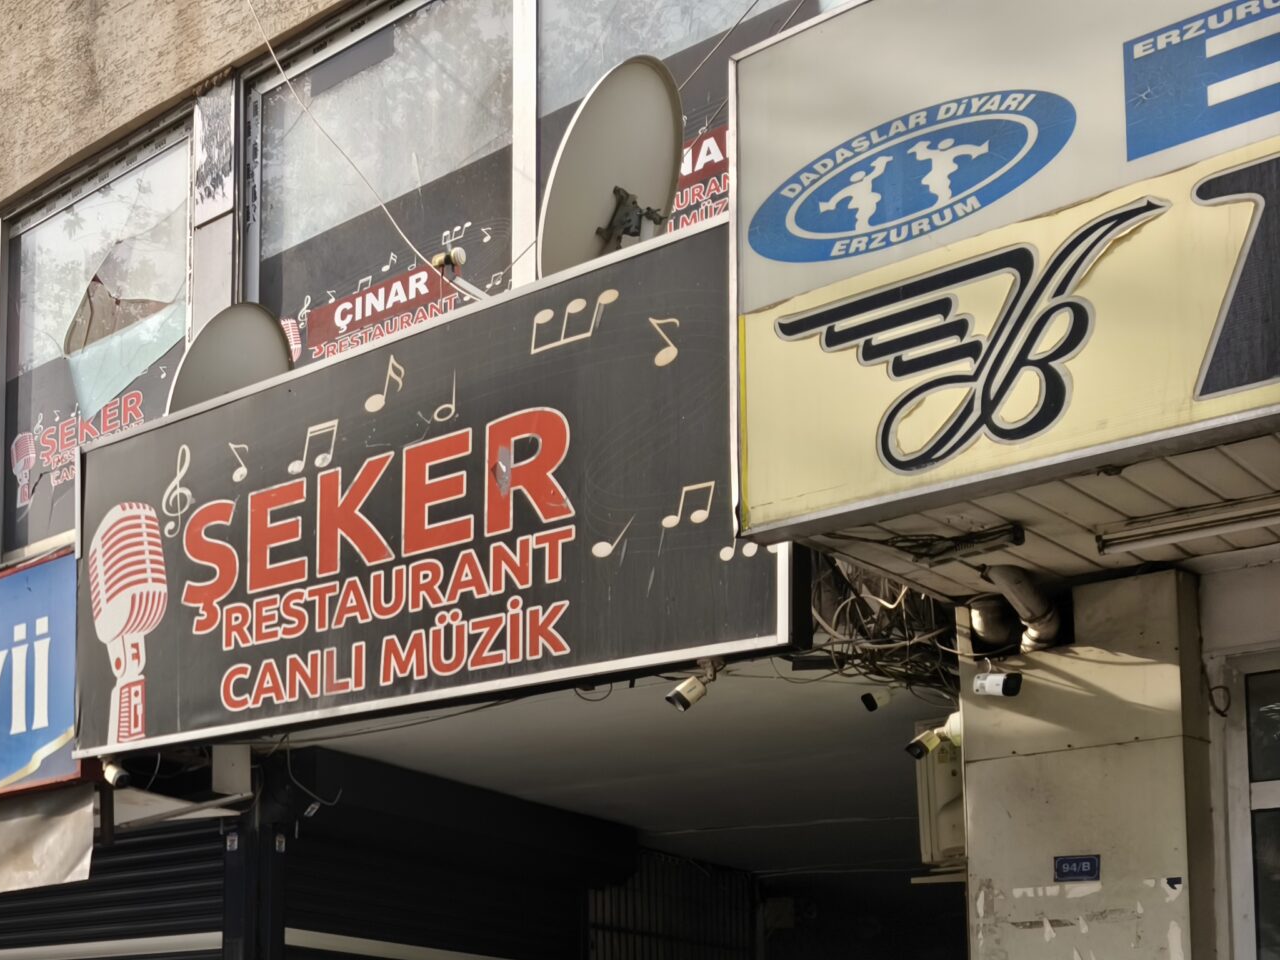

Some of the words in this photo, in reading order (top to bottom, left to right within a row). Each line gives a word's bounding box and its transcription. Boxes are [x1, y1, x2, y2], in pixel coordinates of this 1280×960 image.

[1133, 0, 1280, 59] ERZUR
[829, 195, 983, 257] ERZURUM
[334, 270, 429, 333] ÇINAR
[181, 405, 576, 635] ŞEKER
[221, 525, 576, 650] RESTAURANT
[220, 647, 364, 711] CANLI
[379, 596, 571, 685] MÜZİK
[1061, 861, 1091, 873] 94/B
